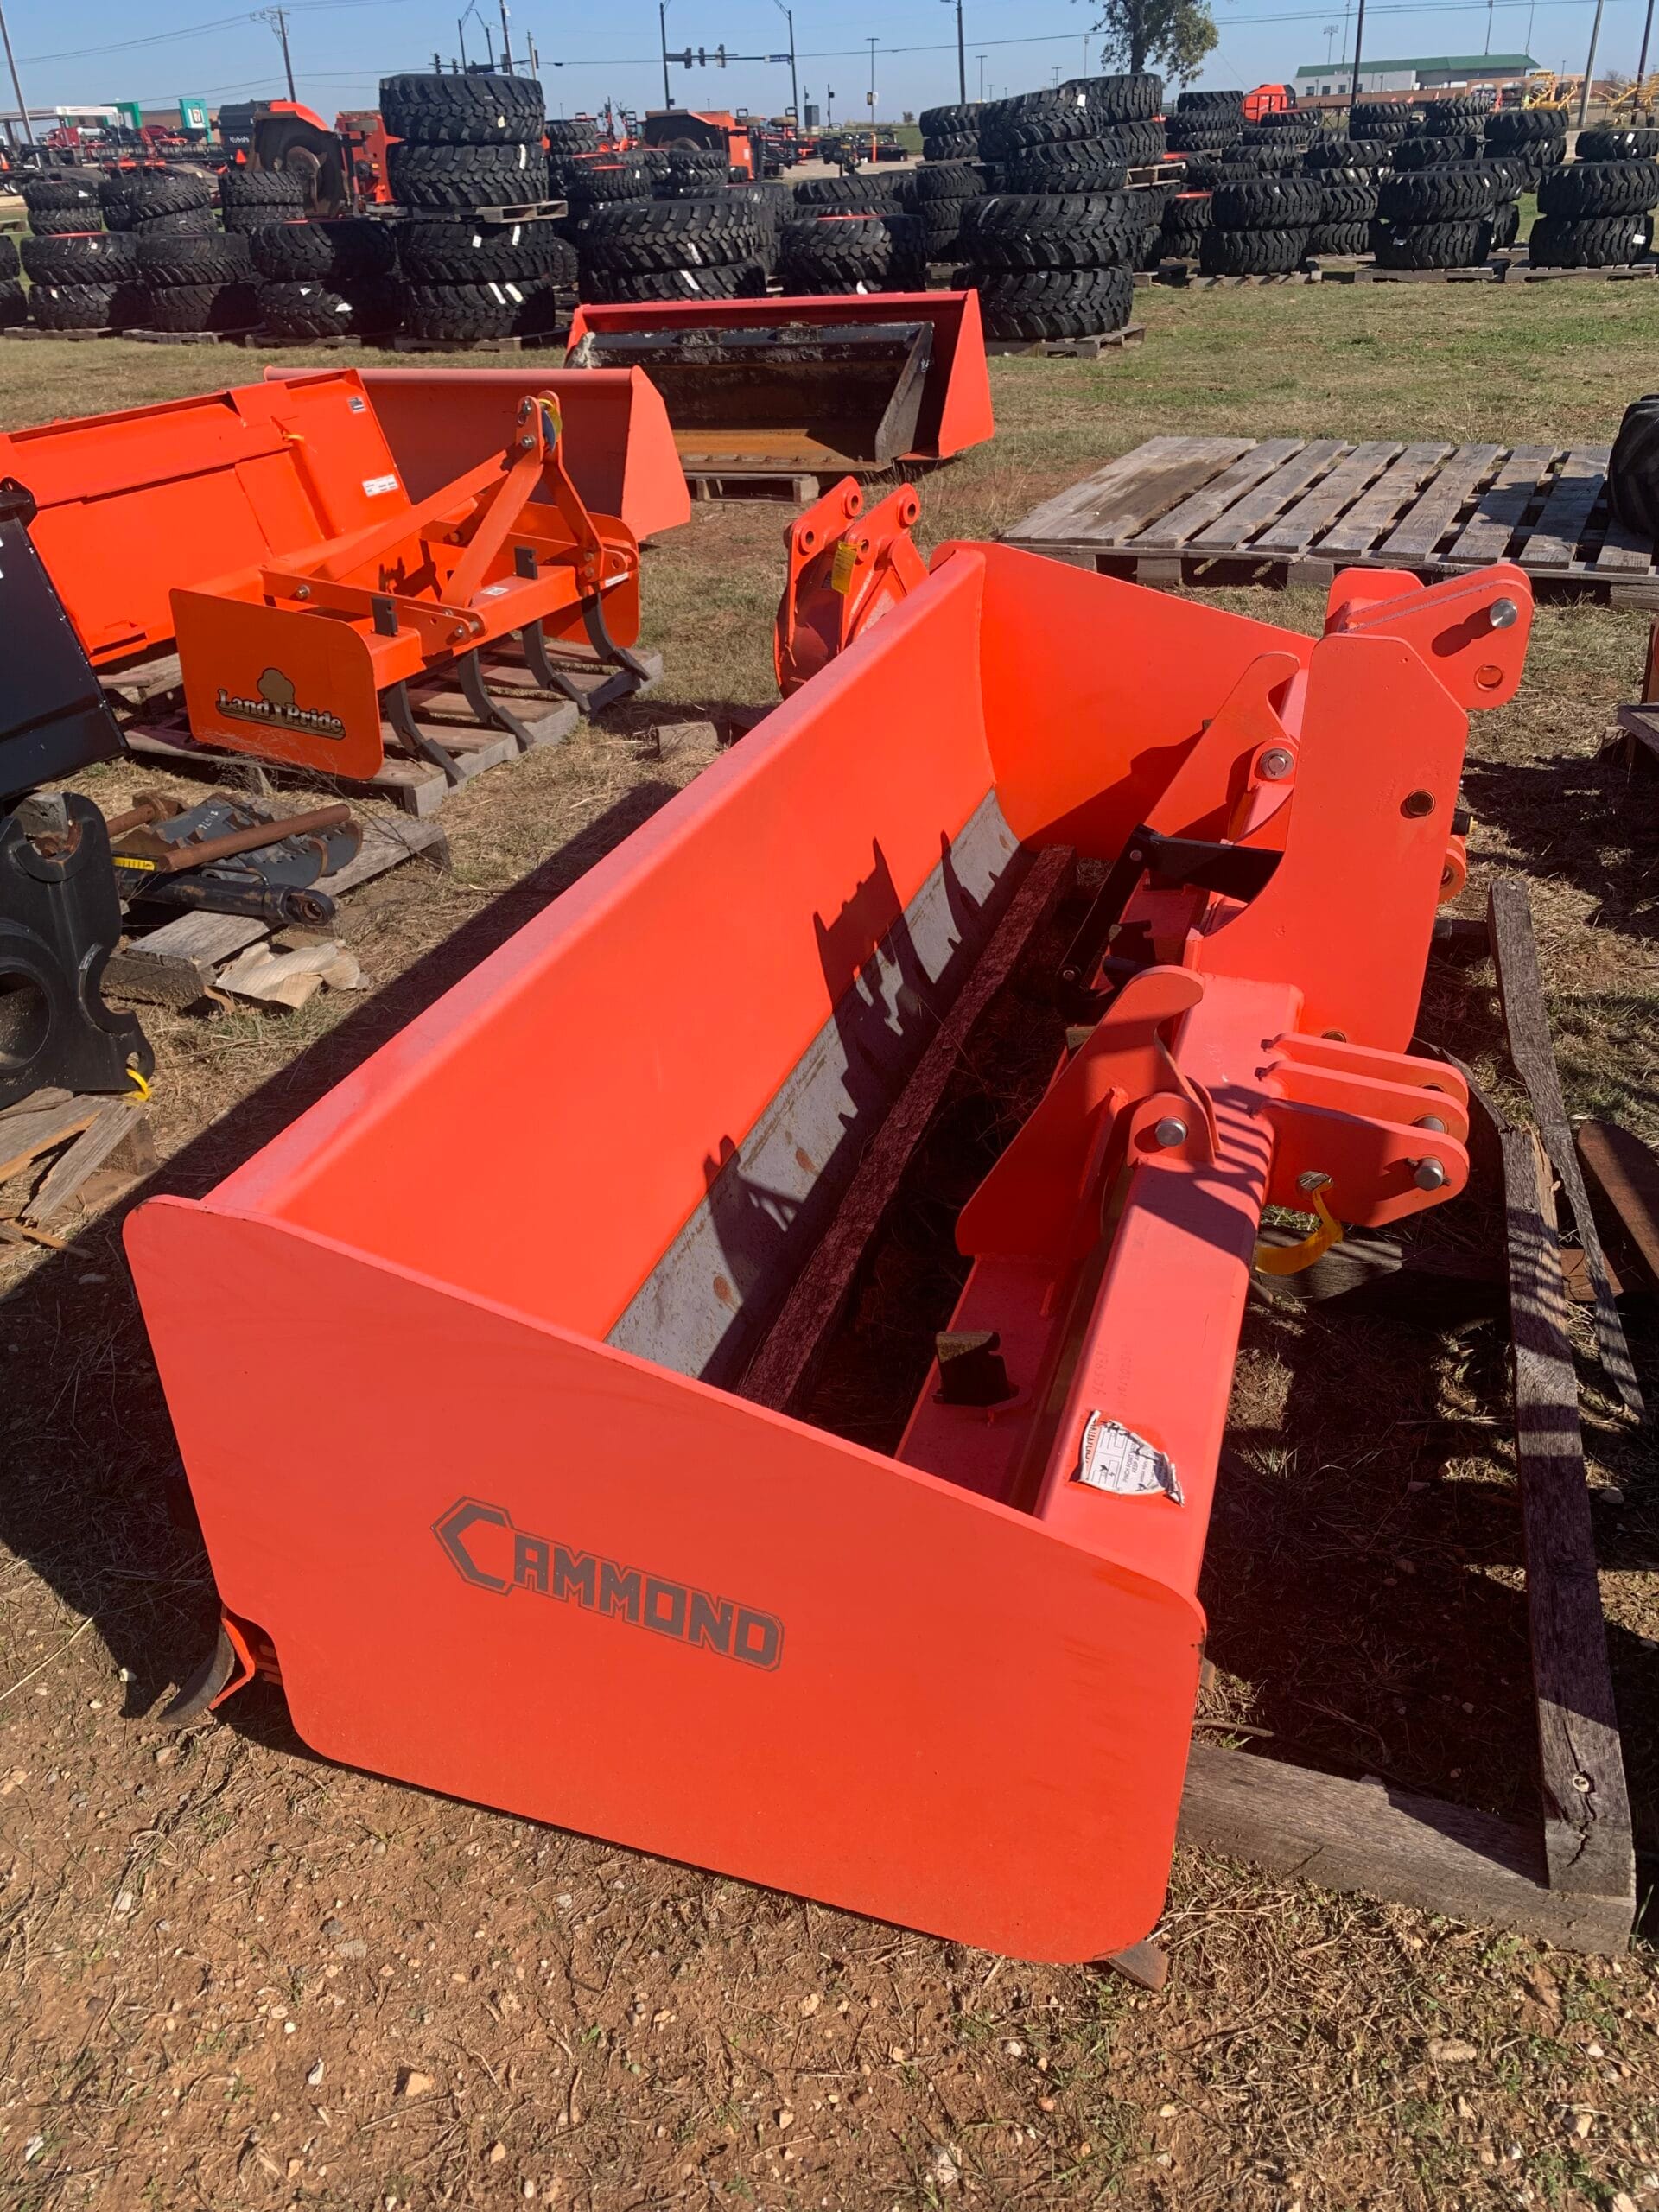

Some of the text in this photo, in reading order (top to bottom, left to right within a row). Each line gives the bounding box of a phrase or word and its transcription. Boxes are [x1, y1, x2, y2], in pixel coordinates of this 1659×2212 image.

[217, 690, 343, 733] Land Pride
[433, 1497, 784, 1671] CAMMOND
